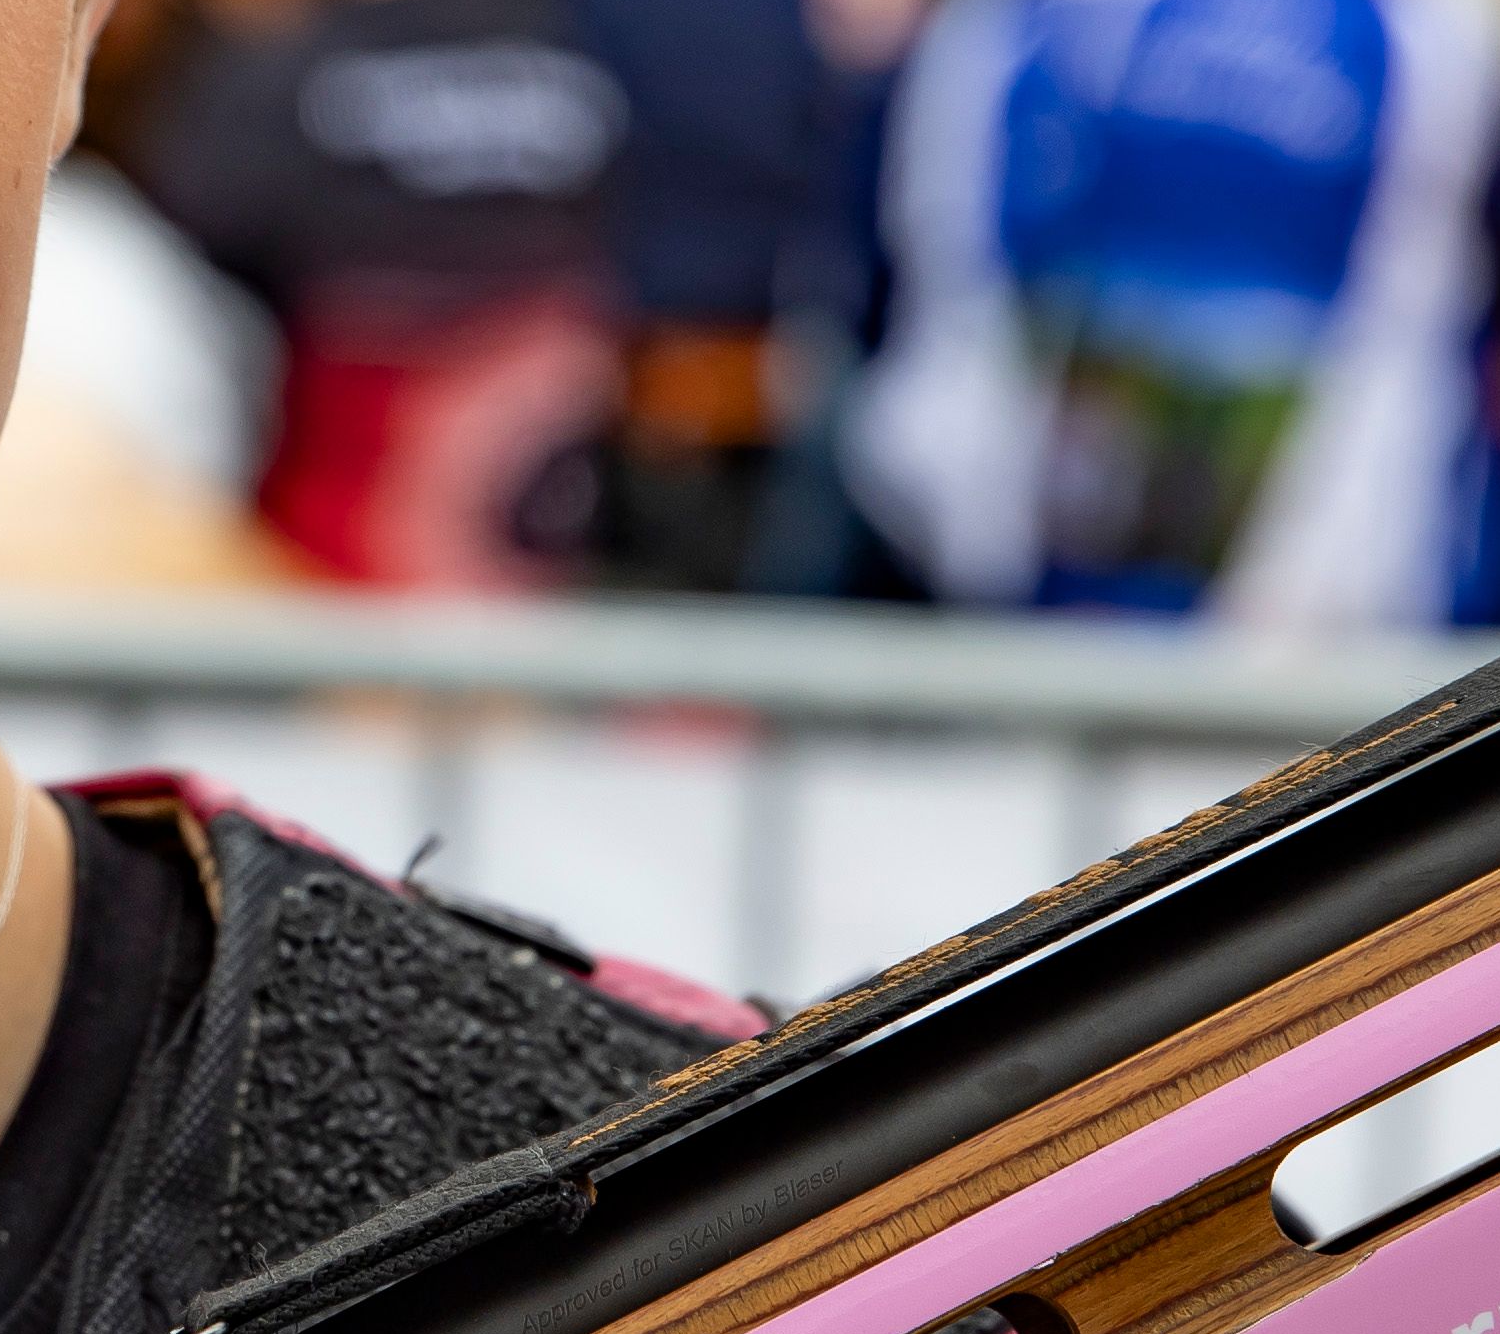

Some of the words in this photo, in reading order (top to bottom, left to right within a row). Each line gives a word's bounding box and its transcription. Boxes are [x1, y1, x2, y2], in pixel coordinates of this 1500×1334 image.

[634, 1251, 661, 1282] for
[669, 1210, 734, 1263] SKAN
[741, 1198, 768, 1228] by
[773, 1160, 844, 1207] Blaser
